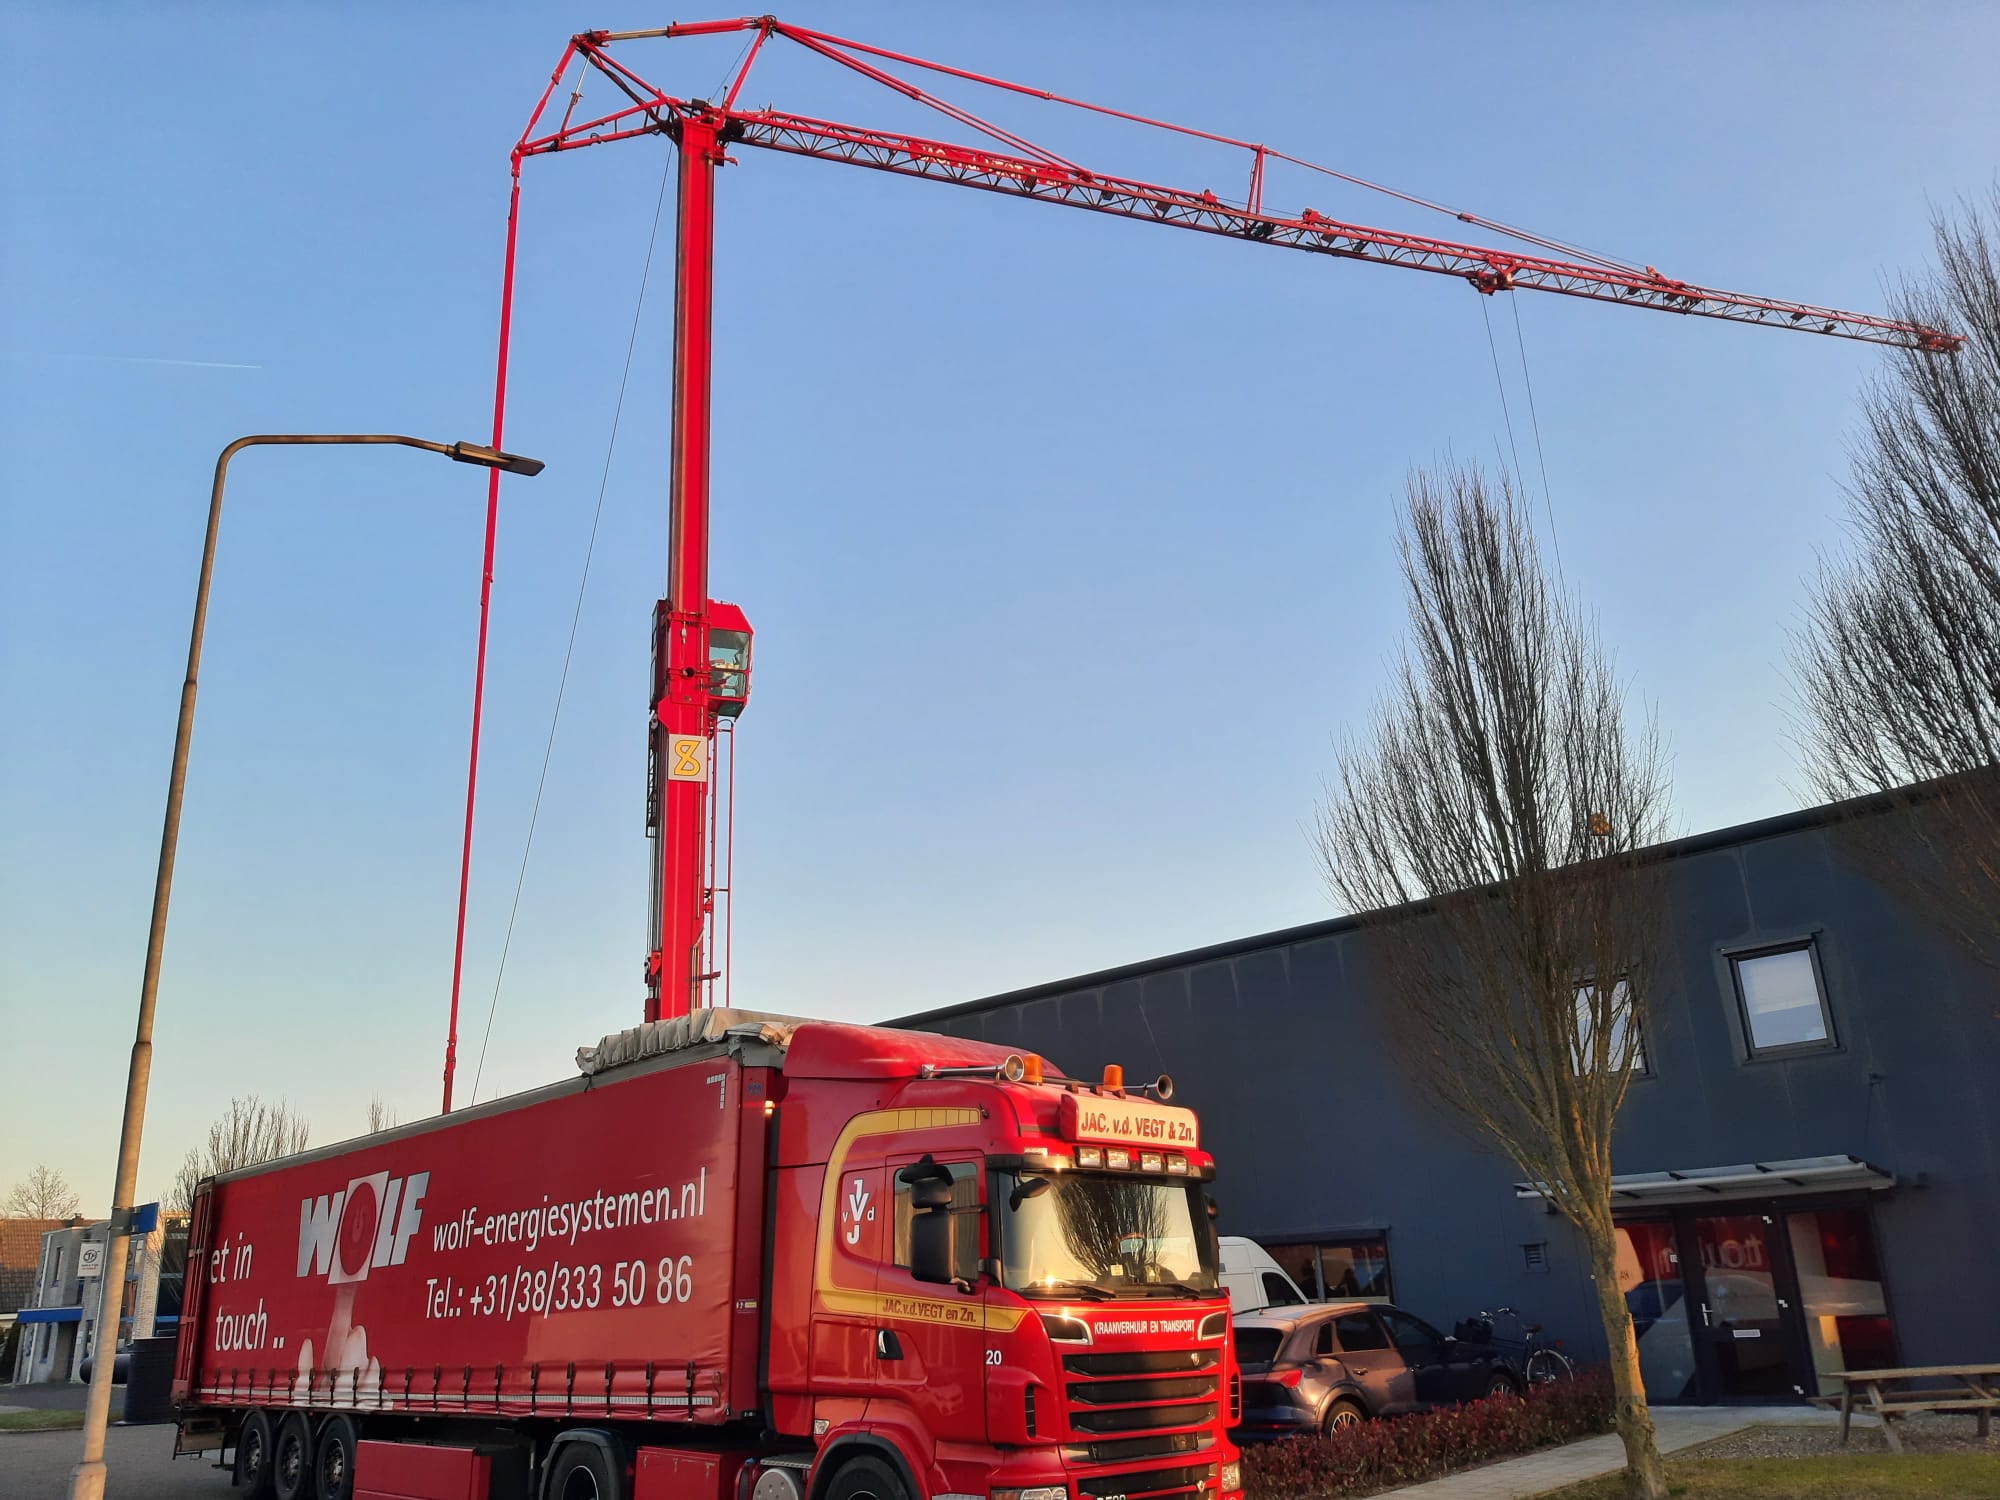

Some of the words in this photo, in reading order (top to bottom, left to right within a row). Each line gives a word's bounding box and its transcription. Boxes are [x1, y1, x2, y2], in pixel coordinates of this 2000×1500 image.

[1081, 1112, 1110, 1133] JAC.
[1112, 1116, 1133, 1135] v.d.
[1135, 1117, 1165, 1139] VEGT
[1168, 1121, 1176, 1140] &
[1178, 1122, 1195, 1142] Zn.
[296, 1170, 431, 1285] WOLF
[433, 1166, 706, 1252] wolf-energiesystemen.nl
[210, 1237, 230, 1284] et
[233, 1231, 253, 1281] in
[425, 1276, 464, 1319] Tel.:
[470, 1261, 602, 1321] +31/38/333
[612, 1259, 646, 1307] 50
[655, 1254, 693, 1305] 86
[215, 1297, 268, 1352] touch
[945, 1308, 959, 1321] en
[960, 1307, 977, 1323] Zn.
[1094, 1320, 1148, 1335] KRAANVERHUUR
[1149, 1320, 1159, 1334] EN
[1159, 1319, 1195, 1333] TRANSPORT
[985, 1349, 1003, 1366] 20
